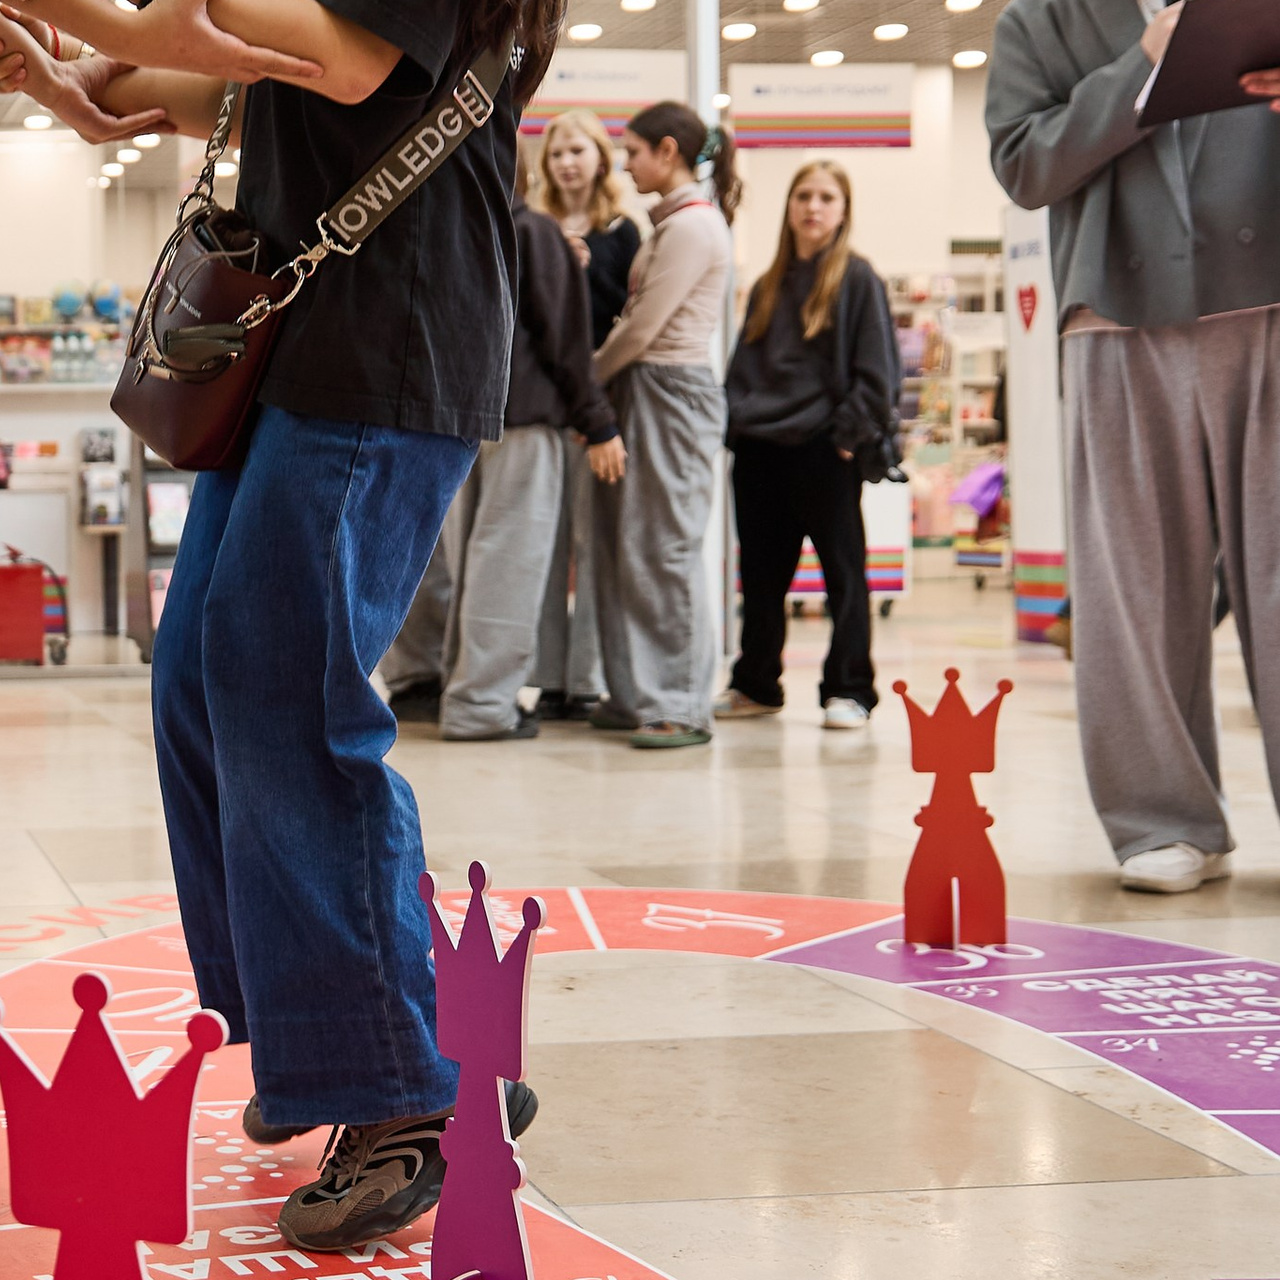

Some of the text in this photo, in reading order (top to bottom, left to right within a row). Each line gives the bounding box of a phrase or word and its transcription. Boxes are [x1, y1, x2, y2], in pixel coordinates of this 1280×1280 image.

[1021, 969, 1280, 992] СДЕЛАЙ
[1098, 984, 1269, 1001] ПЯТЬ
[1100, 996, 1280, 1015] ШАГО
[1140, 1010, 1280, 1027] НАЗ
